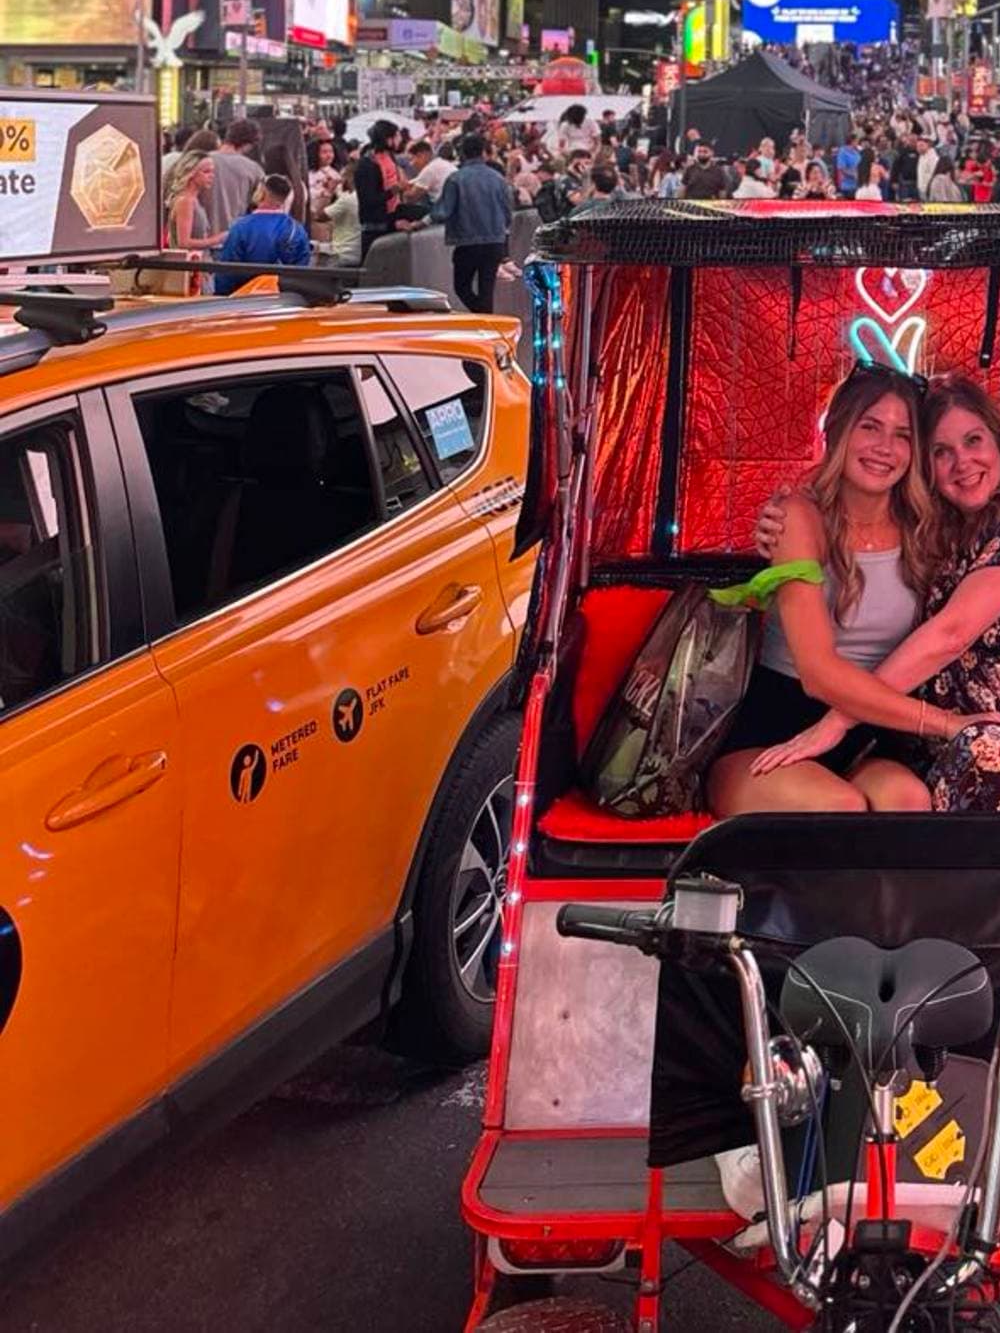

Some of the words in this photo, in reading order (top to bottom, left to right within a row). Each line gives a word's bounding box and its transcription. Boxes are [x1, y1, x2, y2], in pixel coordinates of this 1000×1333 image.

[365, 681, 388, 701] FLAT
[388, 666, 411, 689] FARE
[368, 697, 386, 716] JFK
[270, 719, 317, 756] METERED
[272, 747, 300, 774] FARE
